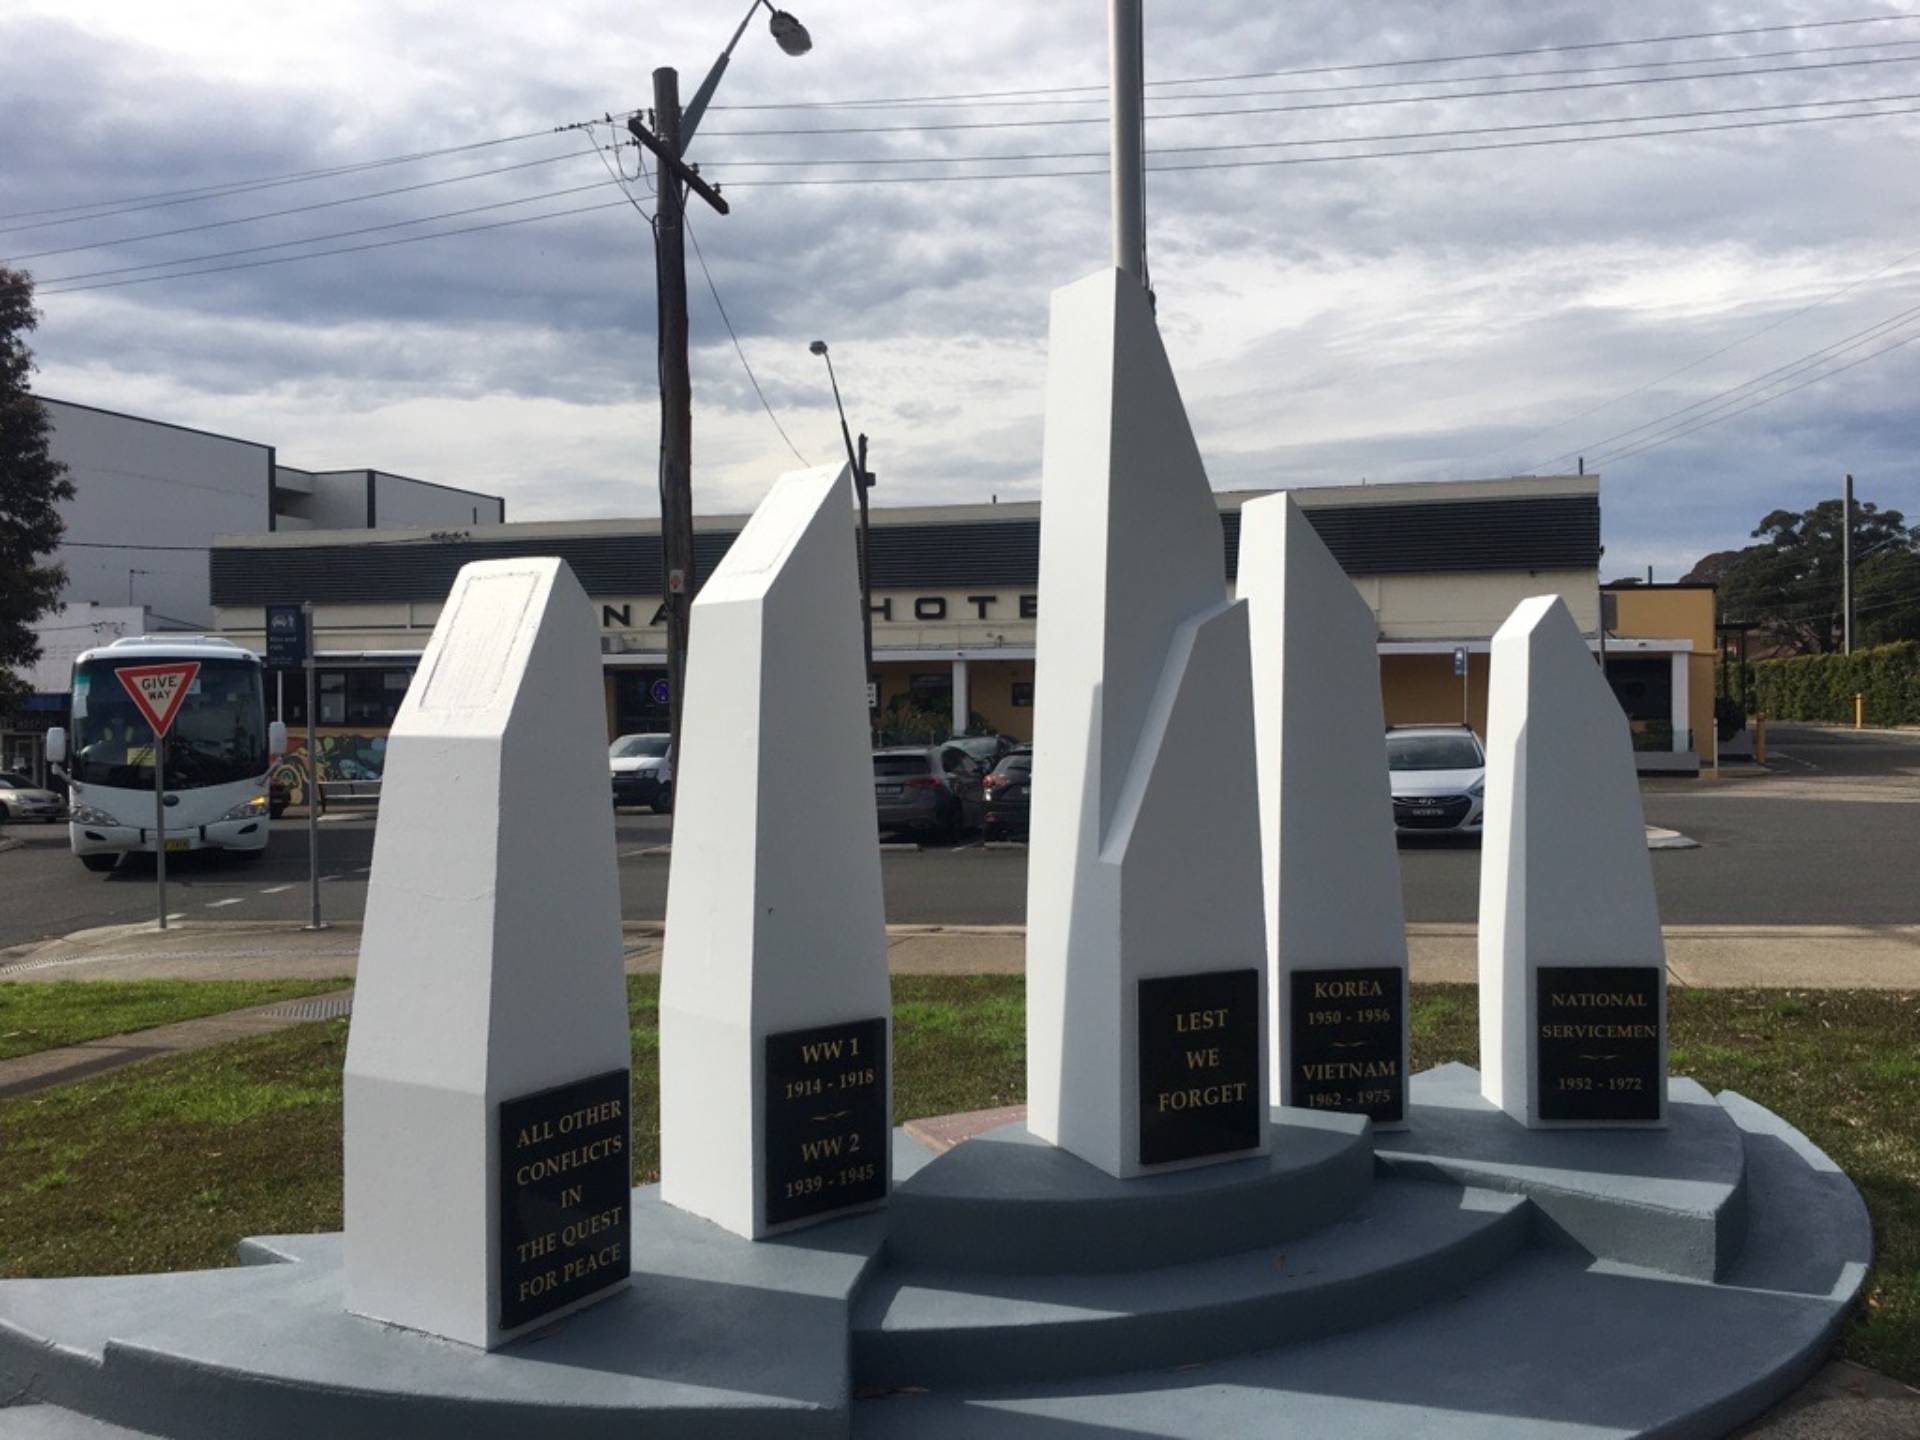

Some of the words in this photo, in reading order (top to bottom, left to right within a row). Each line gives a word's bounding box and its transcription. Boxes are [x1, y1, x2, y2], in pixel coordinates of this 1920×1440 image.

[142, 676, 177, 690] GIVE
[149, 691, 170, 700] WAY
[1314, 981, 1383, 998] KOREA
[1552, 993, 1647, 1006] NATIONAL
[1176, 1009, 1229, 1032] LEST
[1308, 1011, 1341, 1025] 1950
[1358, 1009, 1390, 1022] 1956
[1542, 1025, 1657, 1038] SERVICEMEN
[801, 1040, 843, 1064] WW
[850, 1038, 859, 1055] 1
[1186, 1048, 1220, 1069] WE
[1302, 1061, 1397, 1080] VIETNAM
[785, 1078, 821, 1100] 1914
[840, 1069, 874, 1090] 1918
[1560, 1078, 1592, 1090] 1952
[1609, 1078, 1642, 1090] 1972
[1158, 1083, 1247, 1112] FORGET
[1309, 1093, 1341, 1106] 1962
[1358, 1090, 1390, 1104] 1975
[517, 1124, 554, 1149] ALL
[560, 1100, 622, 1133] OTHER
[801, 1136, 842, 1162] WW
[849, 1134, 860, 1152] 2
[517, 1135, 623, 1186] CONFLICTS
[785, 1176, 822, 1198] 1939
[840, 1164, 874, 1186] 1945
[560, 1185, 582, 1209] IN
[518, 1232, 556, 1263] THE
[562, 1207, 623, 1247] QUEST
[520, 1270, 557, 1301] FOR
[563, 1243, 622, 1284] PEACE
